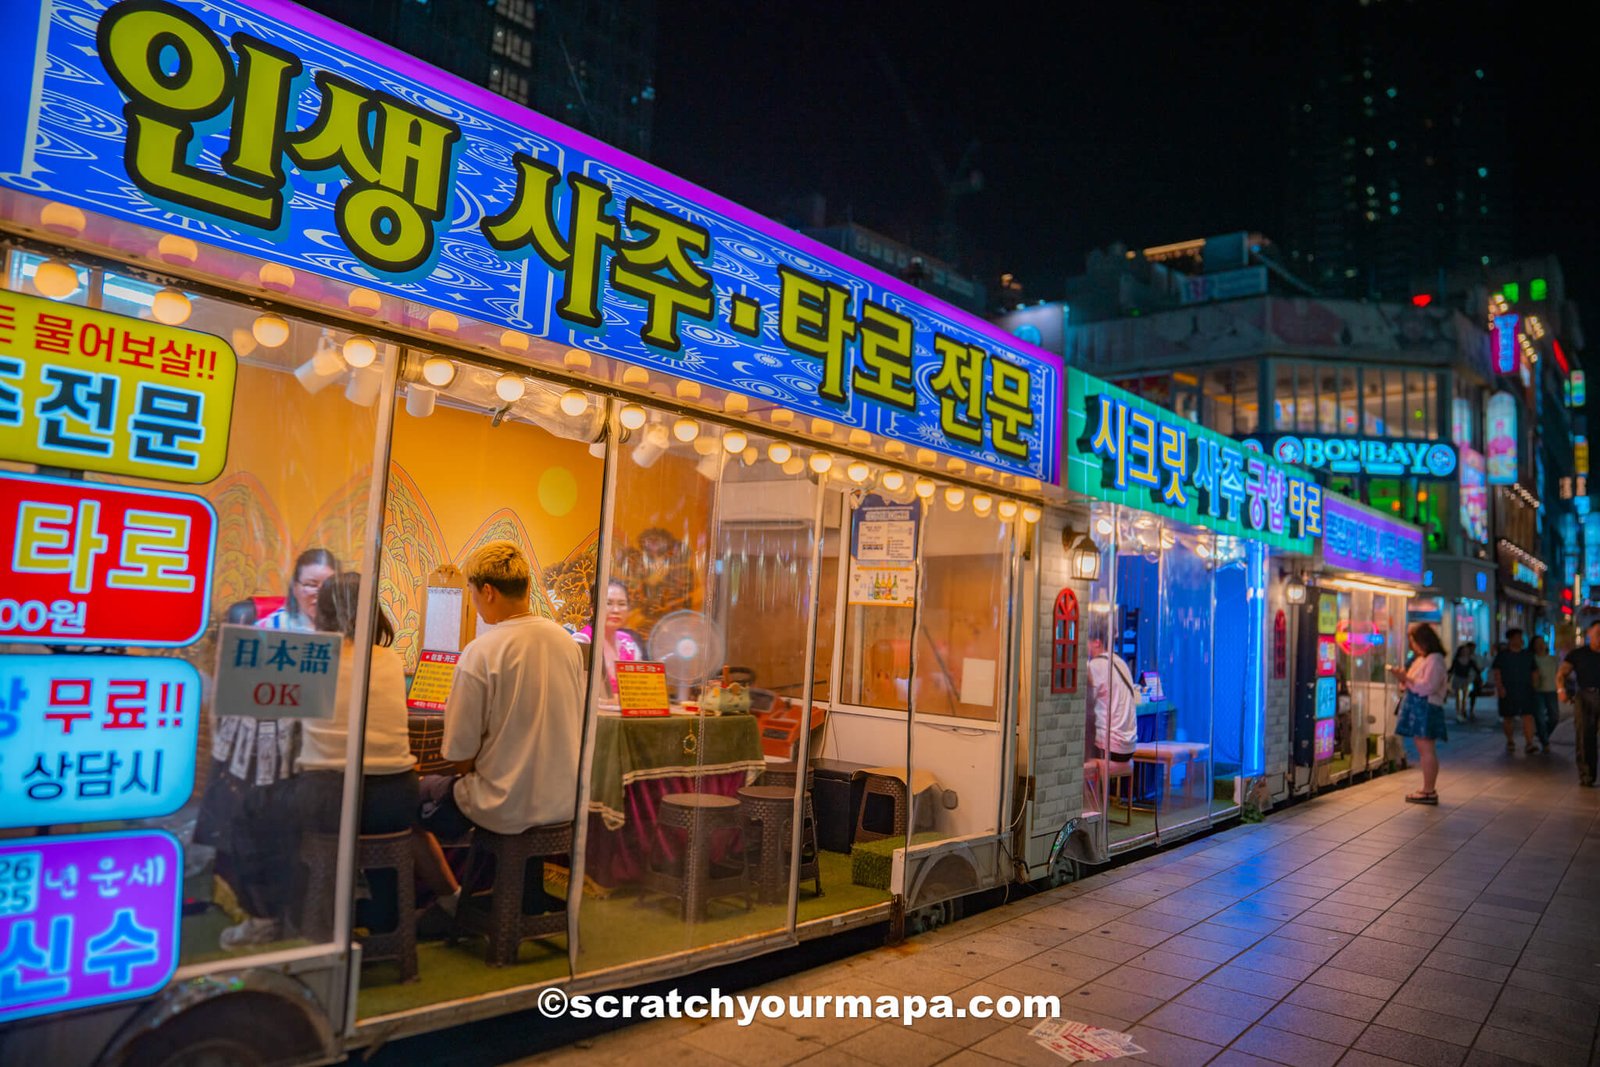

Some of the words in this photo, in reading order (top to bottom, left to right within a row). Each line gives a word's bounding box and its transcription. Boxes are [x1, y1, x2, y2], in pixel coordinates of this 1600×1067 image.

[97, 0, 460, 272] 인생
[930, 331, 1034, 462] 전문
[34, 311, 217, 381] 물어보살!!
[1090, 392, 1188, 509] 시크릿
[1191, 435, 1246, 522] 사주
[1245, 456, 1289, 535] 궁합
[1289, 476, 1323, 541] 타로
[1302, 437, 1431, 475] BOMBAY
[12, 499, 196, 595] 타로
[234, 637, 331, 674] 日本語
[44, 678, 186, 735] 무료!!
[253, 681, 301, 707] OK
[23, 749, 165, 801] 상담시
[45, 864, 78, 898] 년
[88, 854, 166, 898] 운세
[0, 907, 159, 1006] 신수
